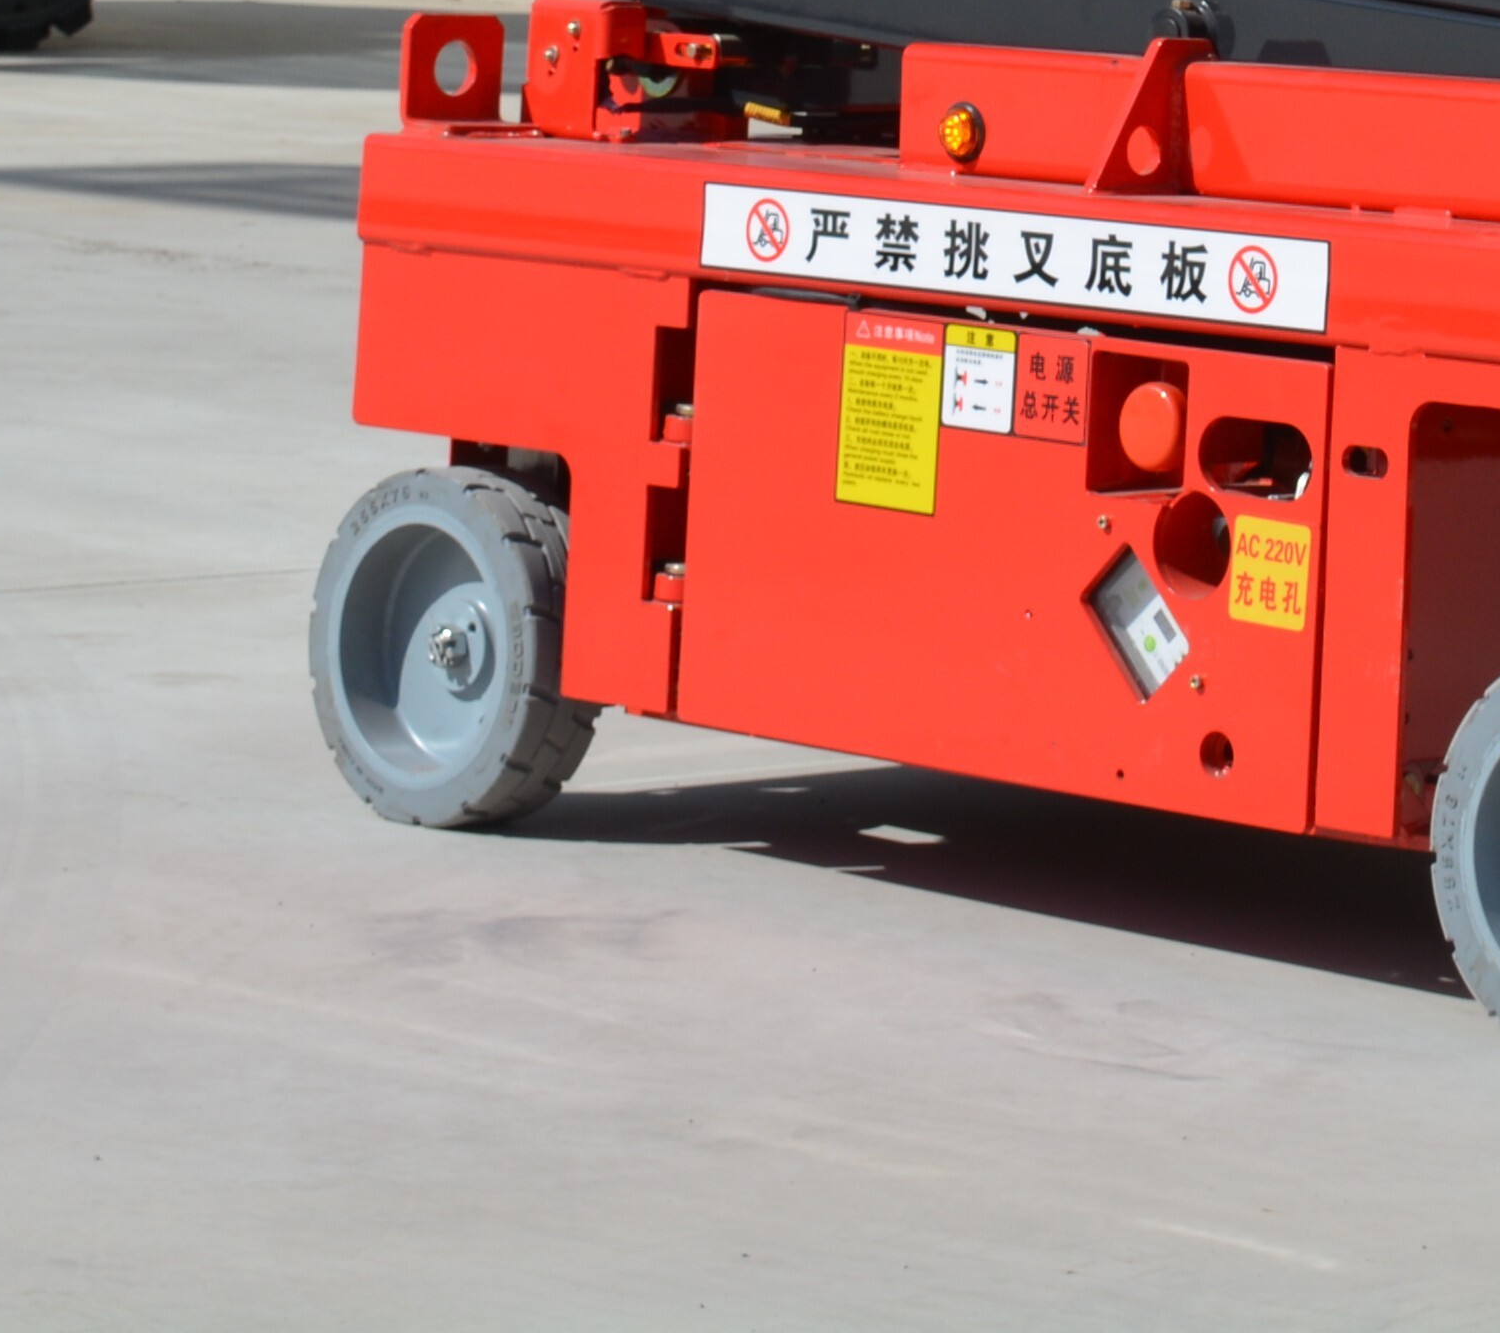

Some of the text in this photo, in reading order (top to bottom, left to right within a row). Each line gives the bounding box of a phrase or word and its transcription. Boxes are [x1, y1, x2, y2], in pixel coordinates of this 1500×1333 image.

[805, 207, 1208, 304] 严禁挑叉底板
[967, 331, 995, 347] 注意
[1029, 351, 1075, 385] 电源
[1020, 391, 1080, 426] 总开关
[1236, 532, 1307, 566] AC 220V
[1234, 572, 1302, 616] 充电孔
